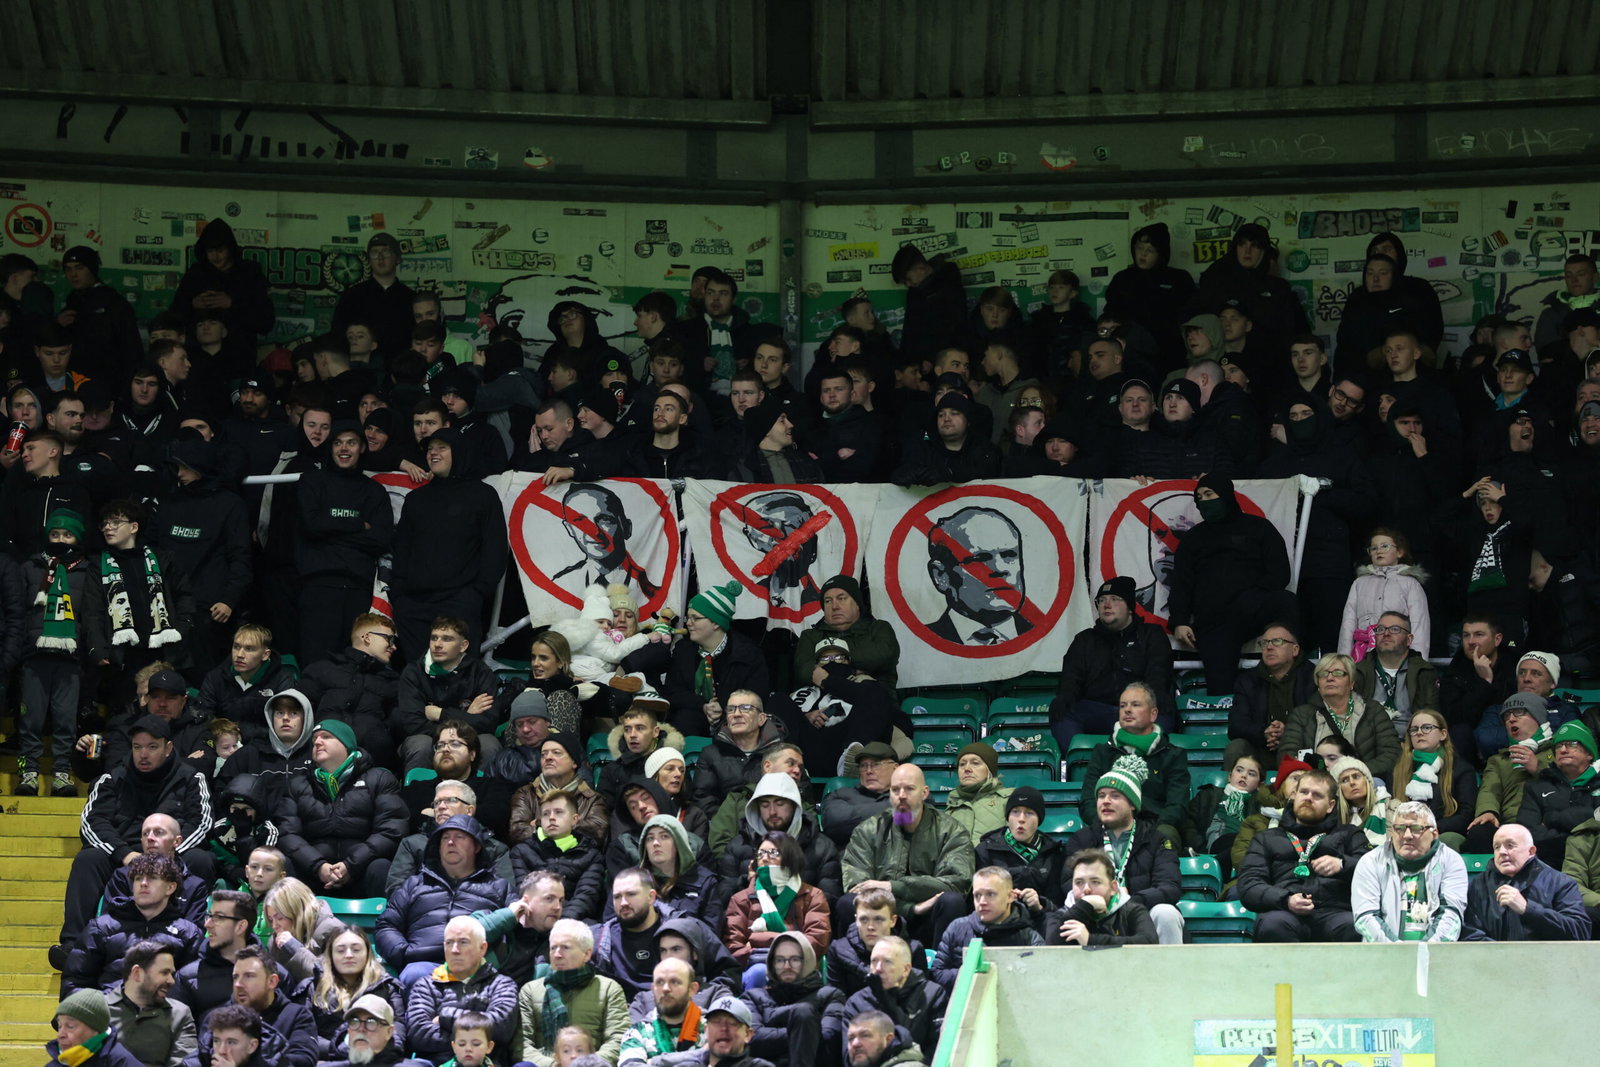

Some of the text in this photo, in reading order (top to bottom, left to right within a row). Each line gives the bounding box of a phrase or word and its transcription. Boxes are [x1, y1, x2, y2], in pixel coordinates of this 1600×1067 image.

[1312, 208, 1403, 238] BHOYS
[171, 525, 201, 538] BHOYS
[1220, 1027, 1317, 1049] BHOS
[1316, 1023, 1400, 1053] XIT CELTIC
